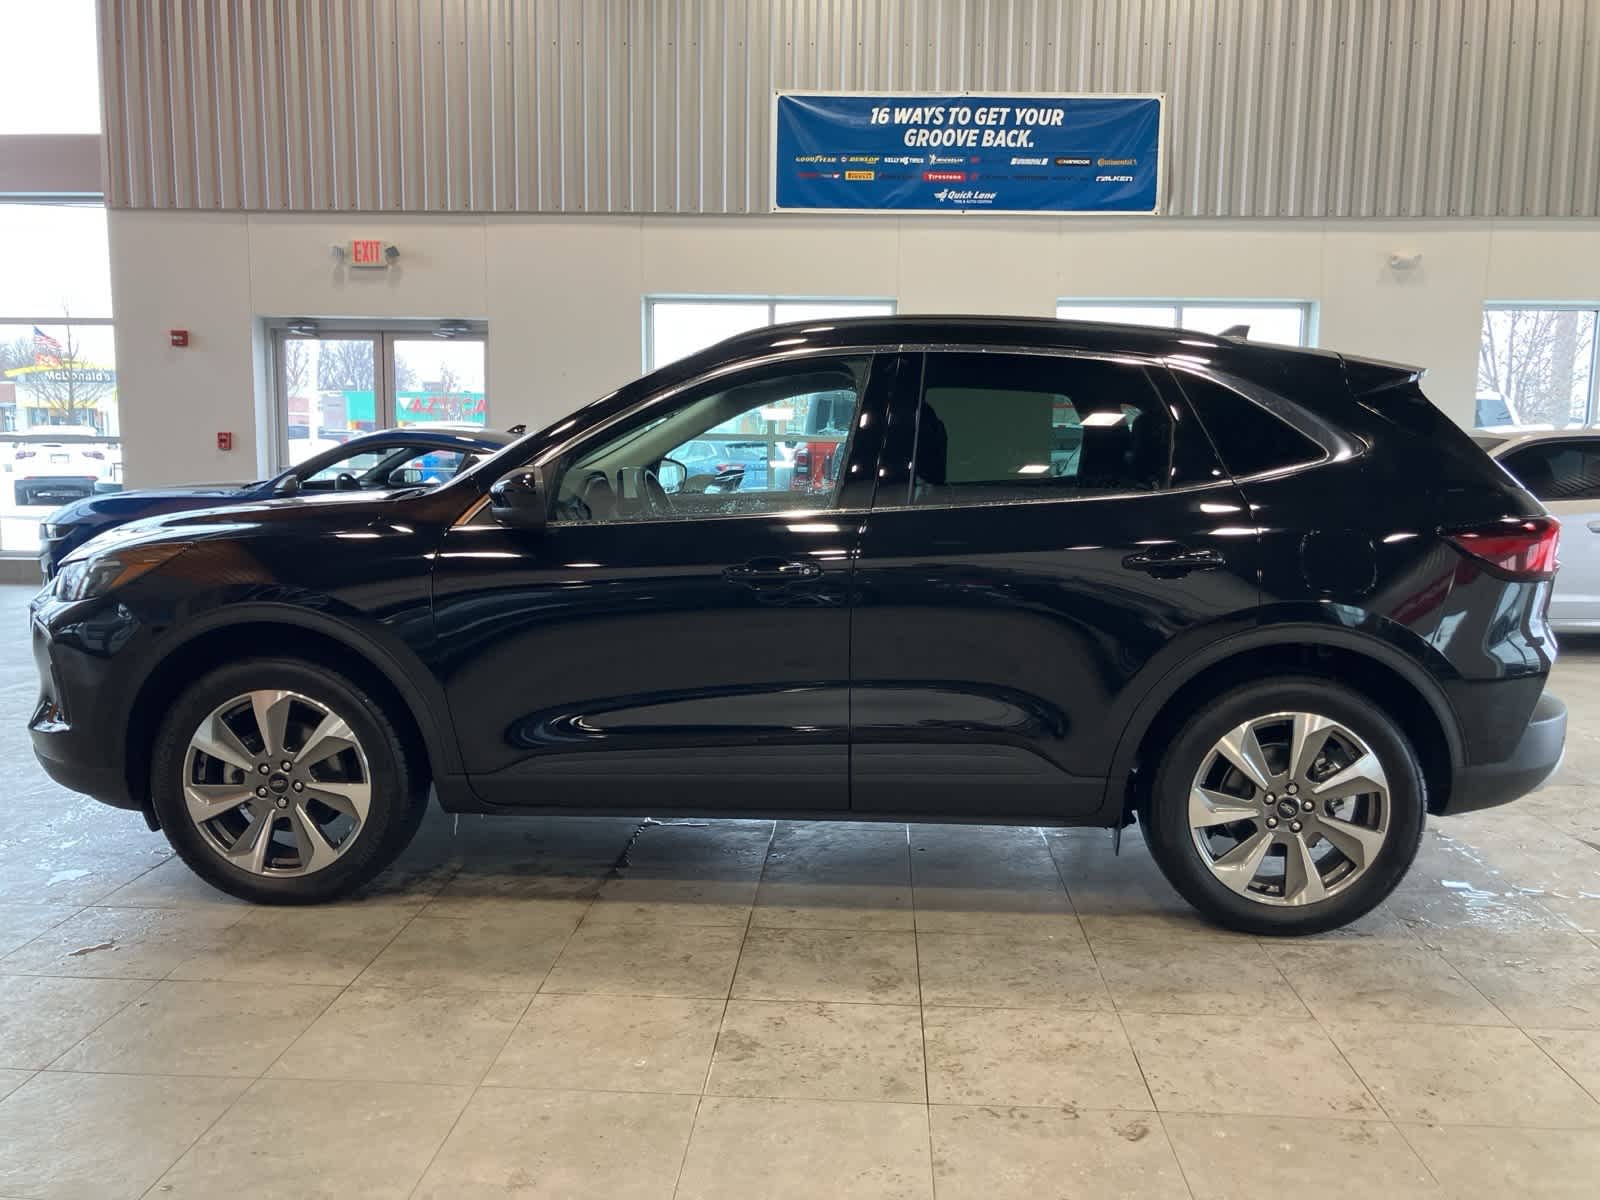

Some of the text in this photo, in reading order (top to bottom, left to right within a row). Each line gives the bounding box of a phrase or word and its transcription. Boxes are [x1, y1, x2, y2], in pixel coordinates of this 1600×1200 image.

[870, 107, 1065, 127] 16 WAYS TO GET YOUR
[903, 128, 1035, 148] GROOVE BACK.
[795, 155, 837, 164] GOODYEAR
[948, 190, 998, 200] Quick Lane
[353, 240, 381, 264] EXIT
[412, 396, 487, 415] AZTCA
